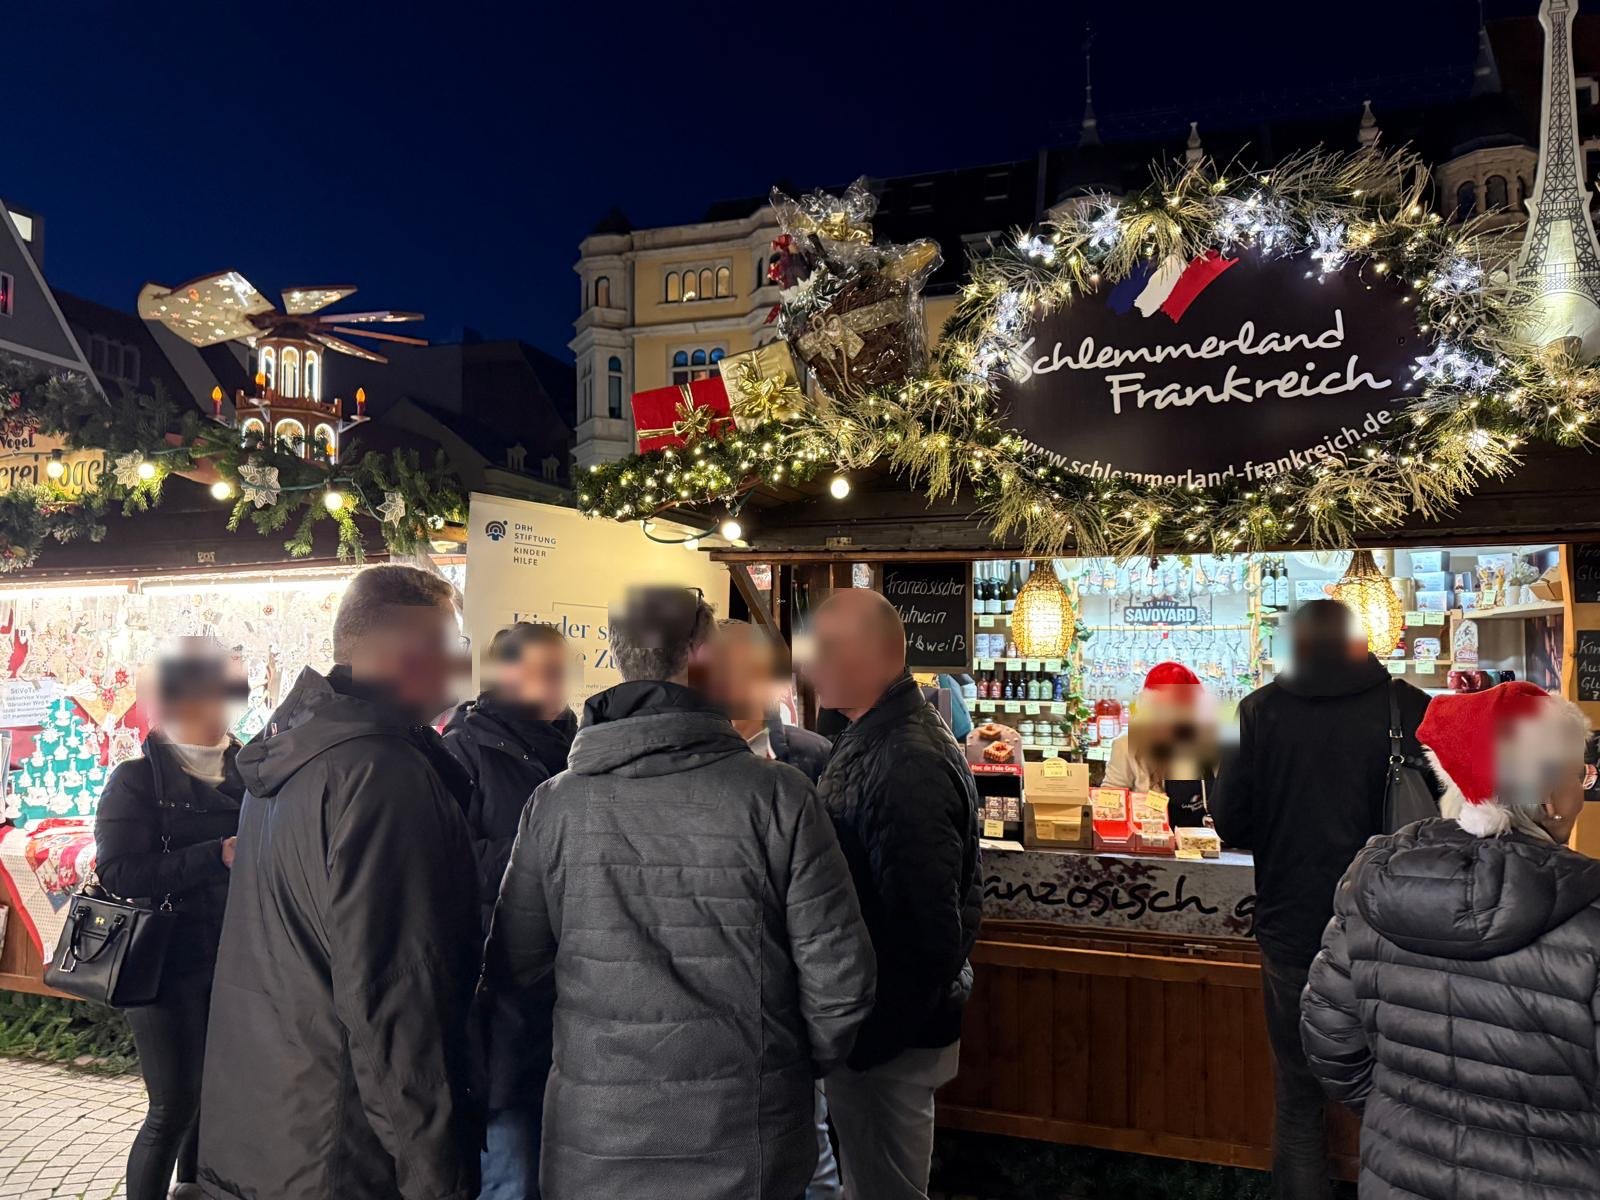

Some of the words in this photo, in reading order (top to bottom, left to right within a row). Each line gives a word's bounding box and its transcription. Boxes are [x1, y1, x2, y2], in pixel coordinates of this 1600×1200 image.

[1014, 309, 1345, 383] Schlemmerland
[1104, 354, 1392, 414] Frankreich
[514, 523, 533, 532] DRH
[514, 533, 557, 545] STIFTUNG
[514, 547, 546, 557] KINDER
[513, 556, 538, 566] HILFE
[885, 571, 966, 596] Französischer
[1125, 608, 1196, 622] SAVOYARD
[983, 874, 1219, 920] anzösisch
